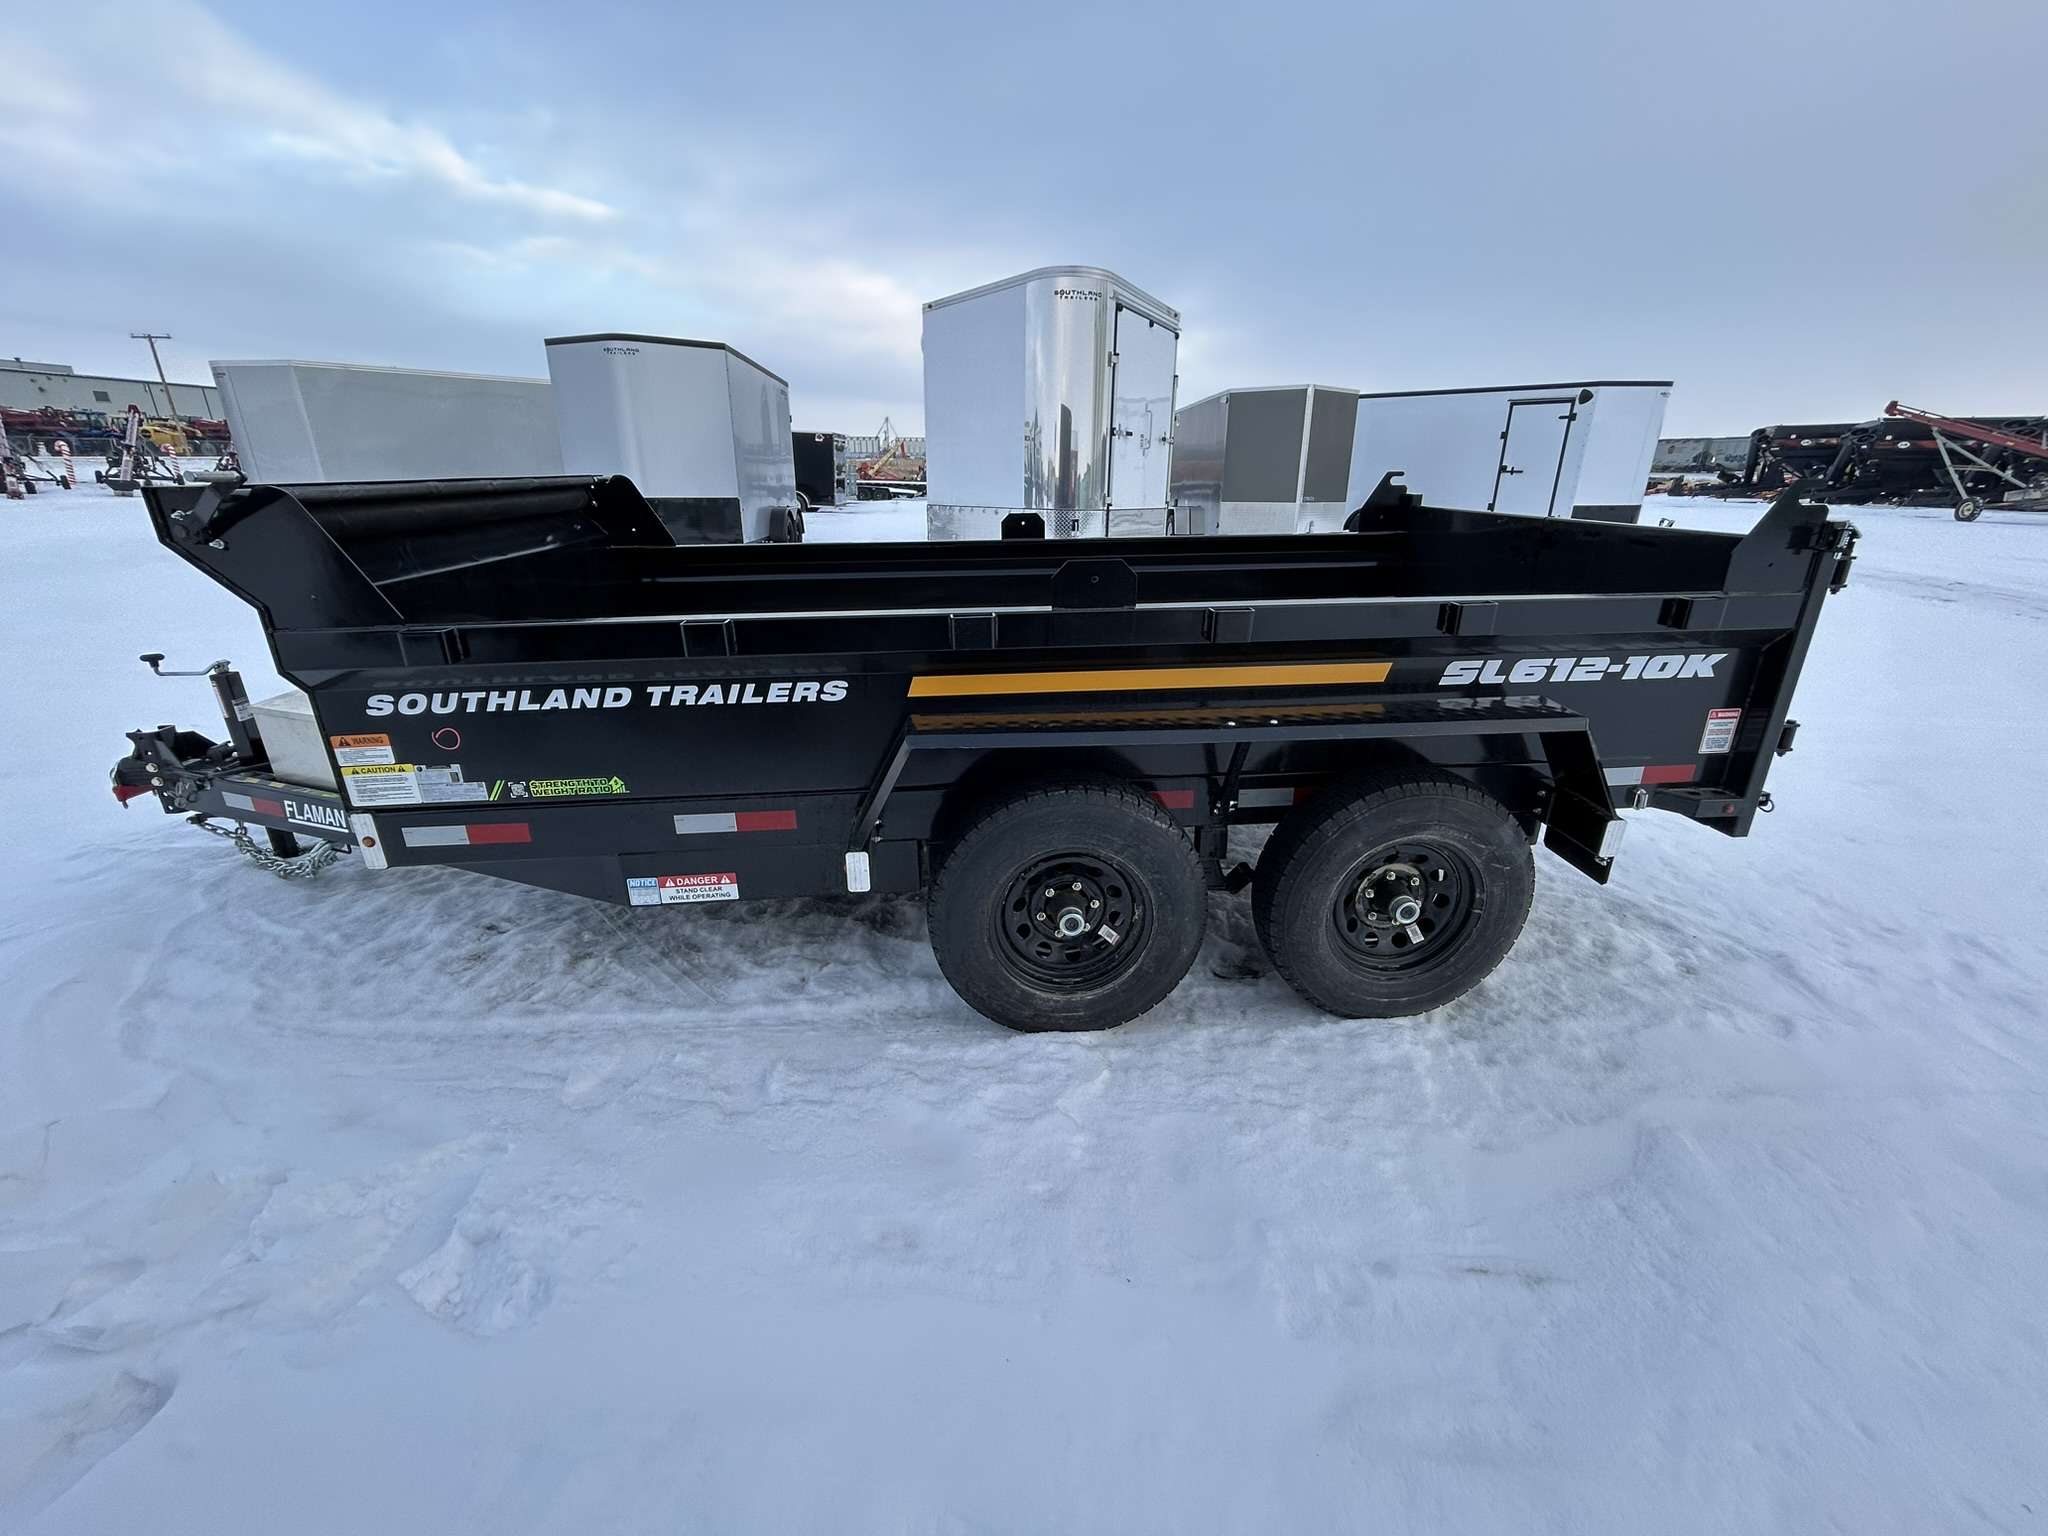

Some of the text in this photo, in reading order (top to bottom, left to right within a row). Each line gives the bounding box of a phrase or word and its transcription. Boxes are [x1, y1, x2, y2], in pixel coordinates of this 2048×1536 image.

[1439, 653, 1729, 686] SL612-10K
[365, 680, 849, 717] SOUTHLAND TRAILERS
[351, 736, 384, 746] WARNING
[360, 766, 396, 775] CAUTION
[530, 778, 608, 789] STRENGTH TO
[531, 786, 611, 797] WEIGHT RATIO
[283, 800, 347, 828] FLAMAN
[629, 879, 657, 887] NOTICE
[676, 876, 719, 886] DANGER
[669, 893, 690, 901] WHILE
[691, 891, 731, 899] OPERATING
